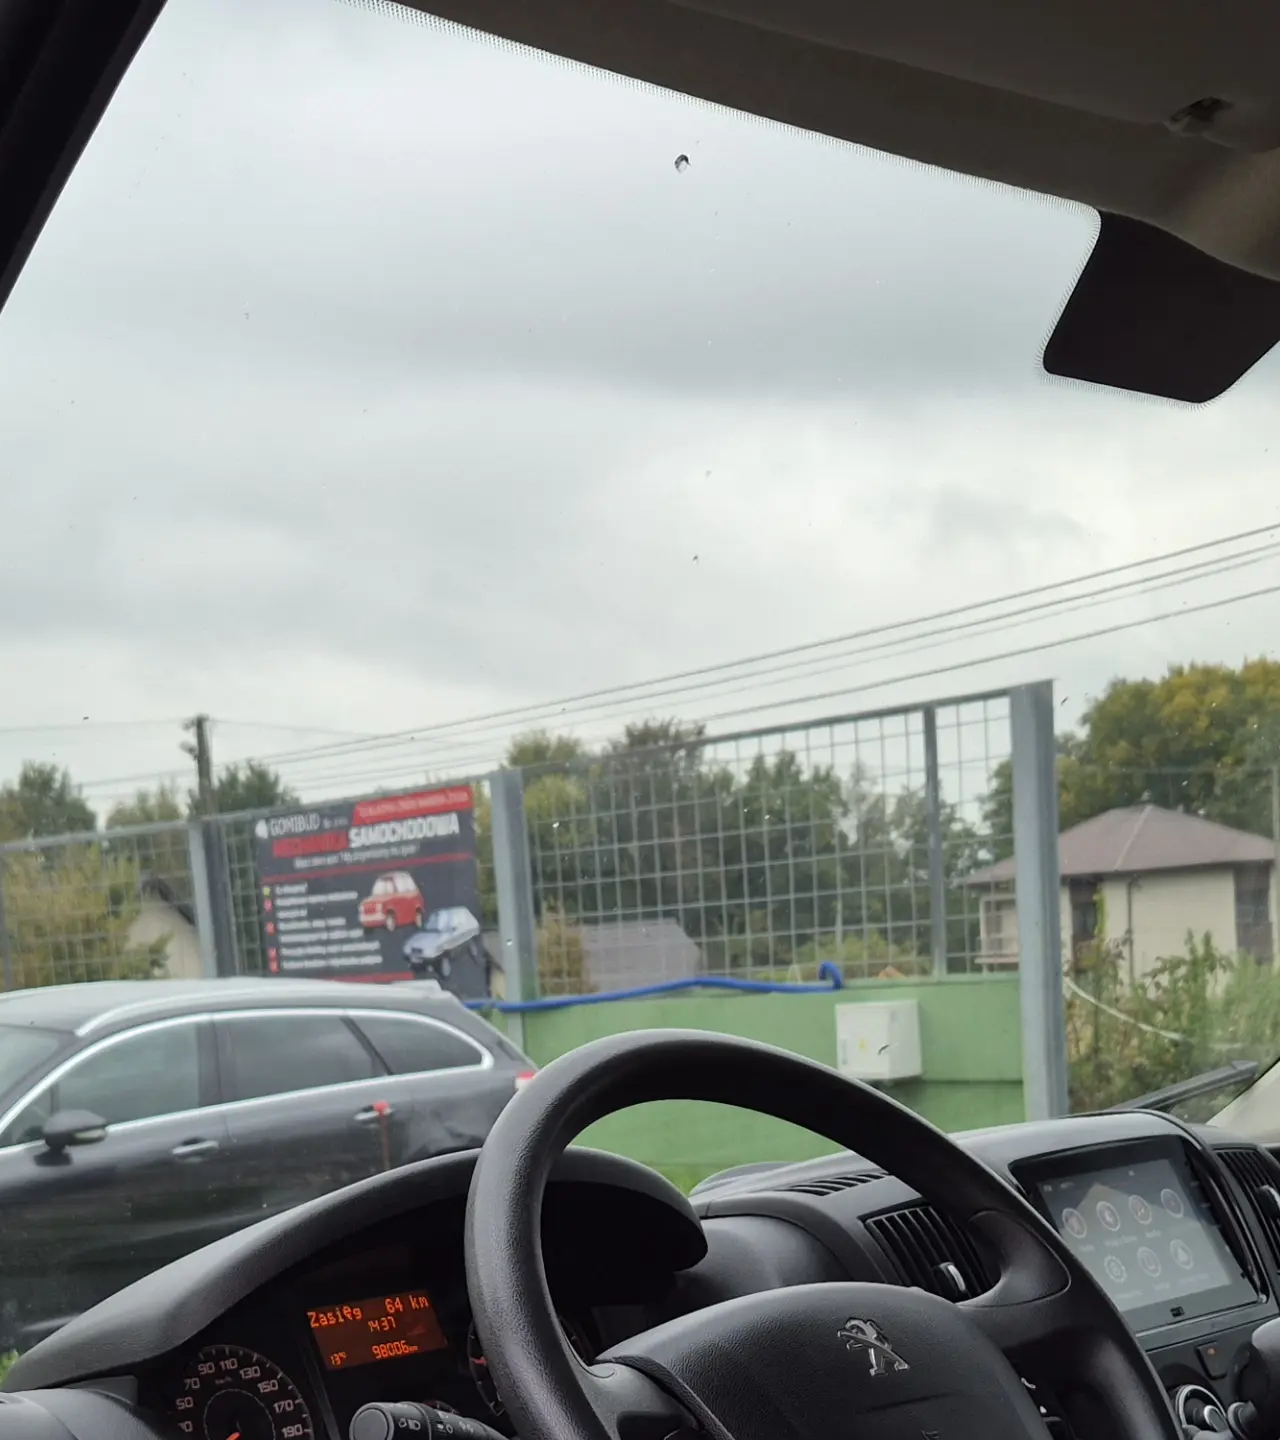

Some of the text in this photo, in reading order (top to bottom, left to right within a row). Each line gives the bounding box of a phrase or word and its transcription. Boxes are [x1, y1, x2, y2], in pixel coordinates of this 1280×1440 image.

[348, 811, 460, 848] SAMOCHODOWA
[306, 1294, 430, 1328] Zasięg 64 km
[198, 1362, 215, 1375] 90
[219, 1358, 238, 1371] 110
[239, 1365, 261, 1379] 130
[184, 1377, 200, 1391] 70
[257, 1379, 279, 1393] 150
[176, 1396, 194, 1410] 50
[273, 1399, 295, 1413] 170
[281, 1423, 303, 1438] 190
